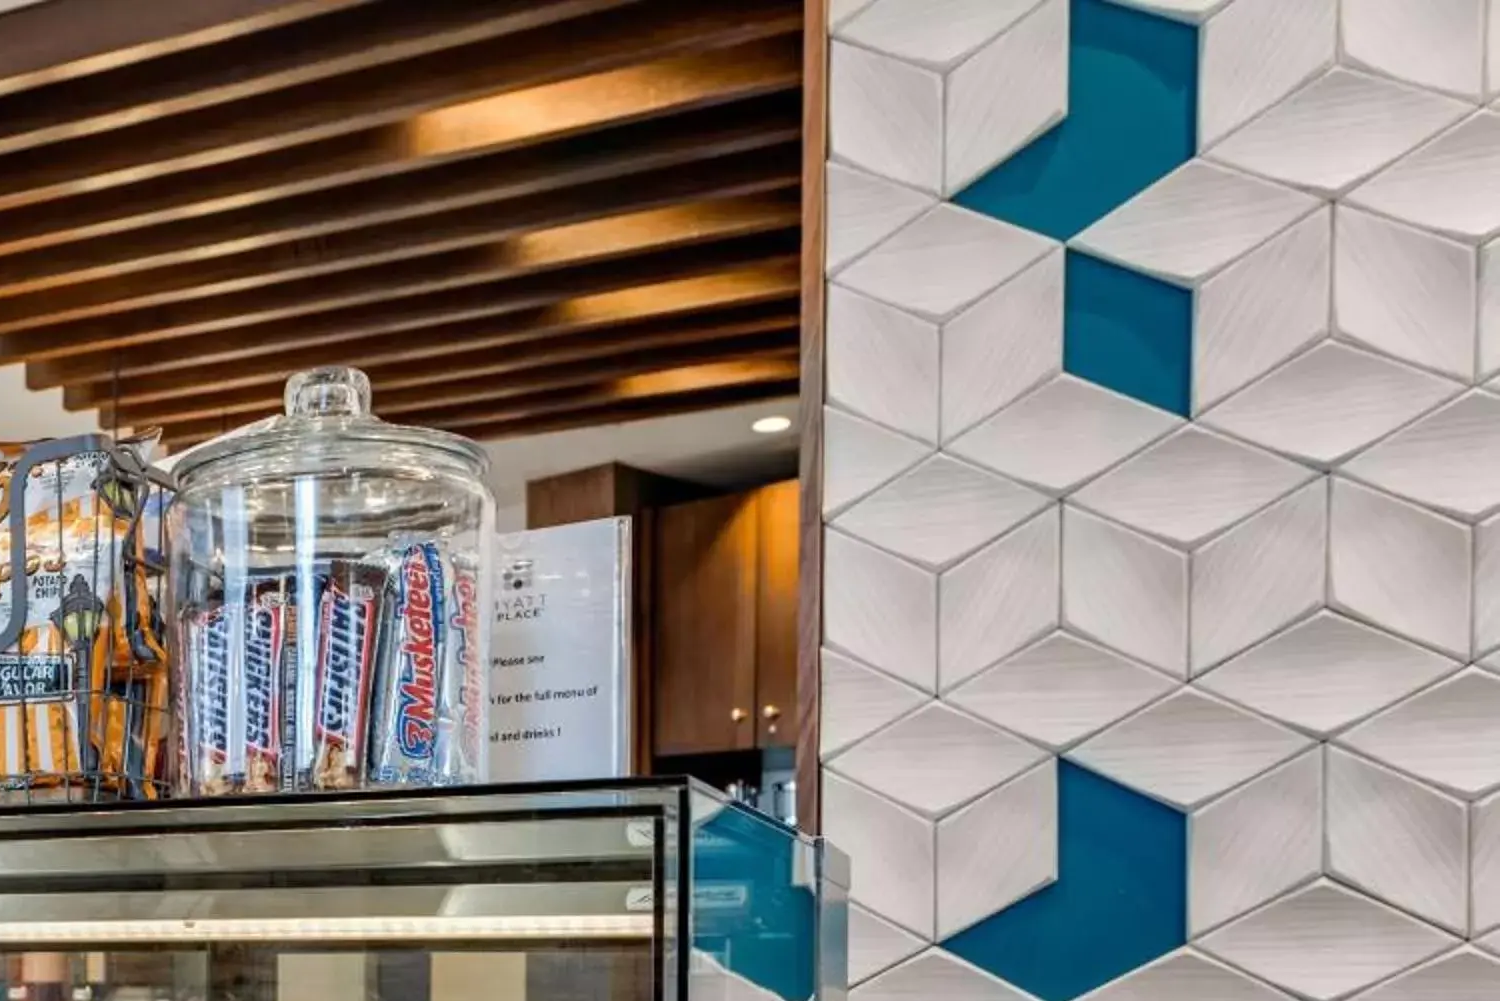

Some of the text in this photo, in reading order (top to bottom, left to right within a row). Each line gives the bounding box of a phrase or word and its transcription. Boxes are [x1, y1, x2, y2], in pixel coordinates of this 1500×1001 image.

[35, 586, 61, 600] CHIP
[497, 607, 542, 622] PLACE
[514, 692, 532, 703] the
